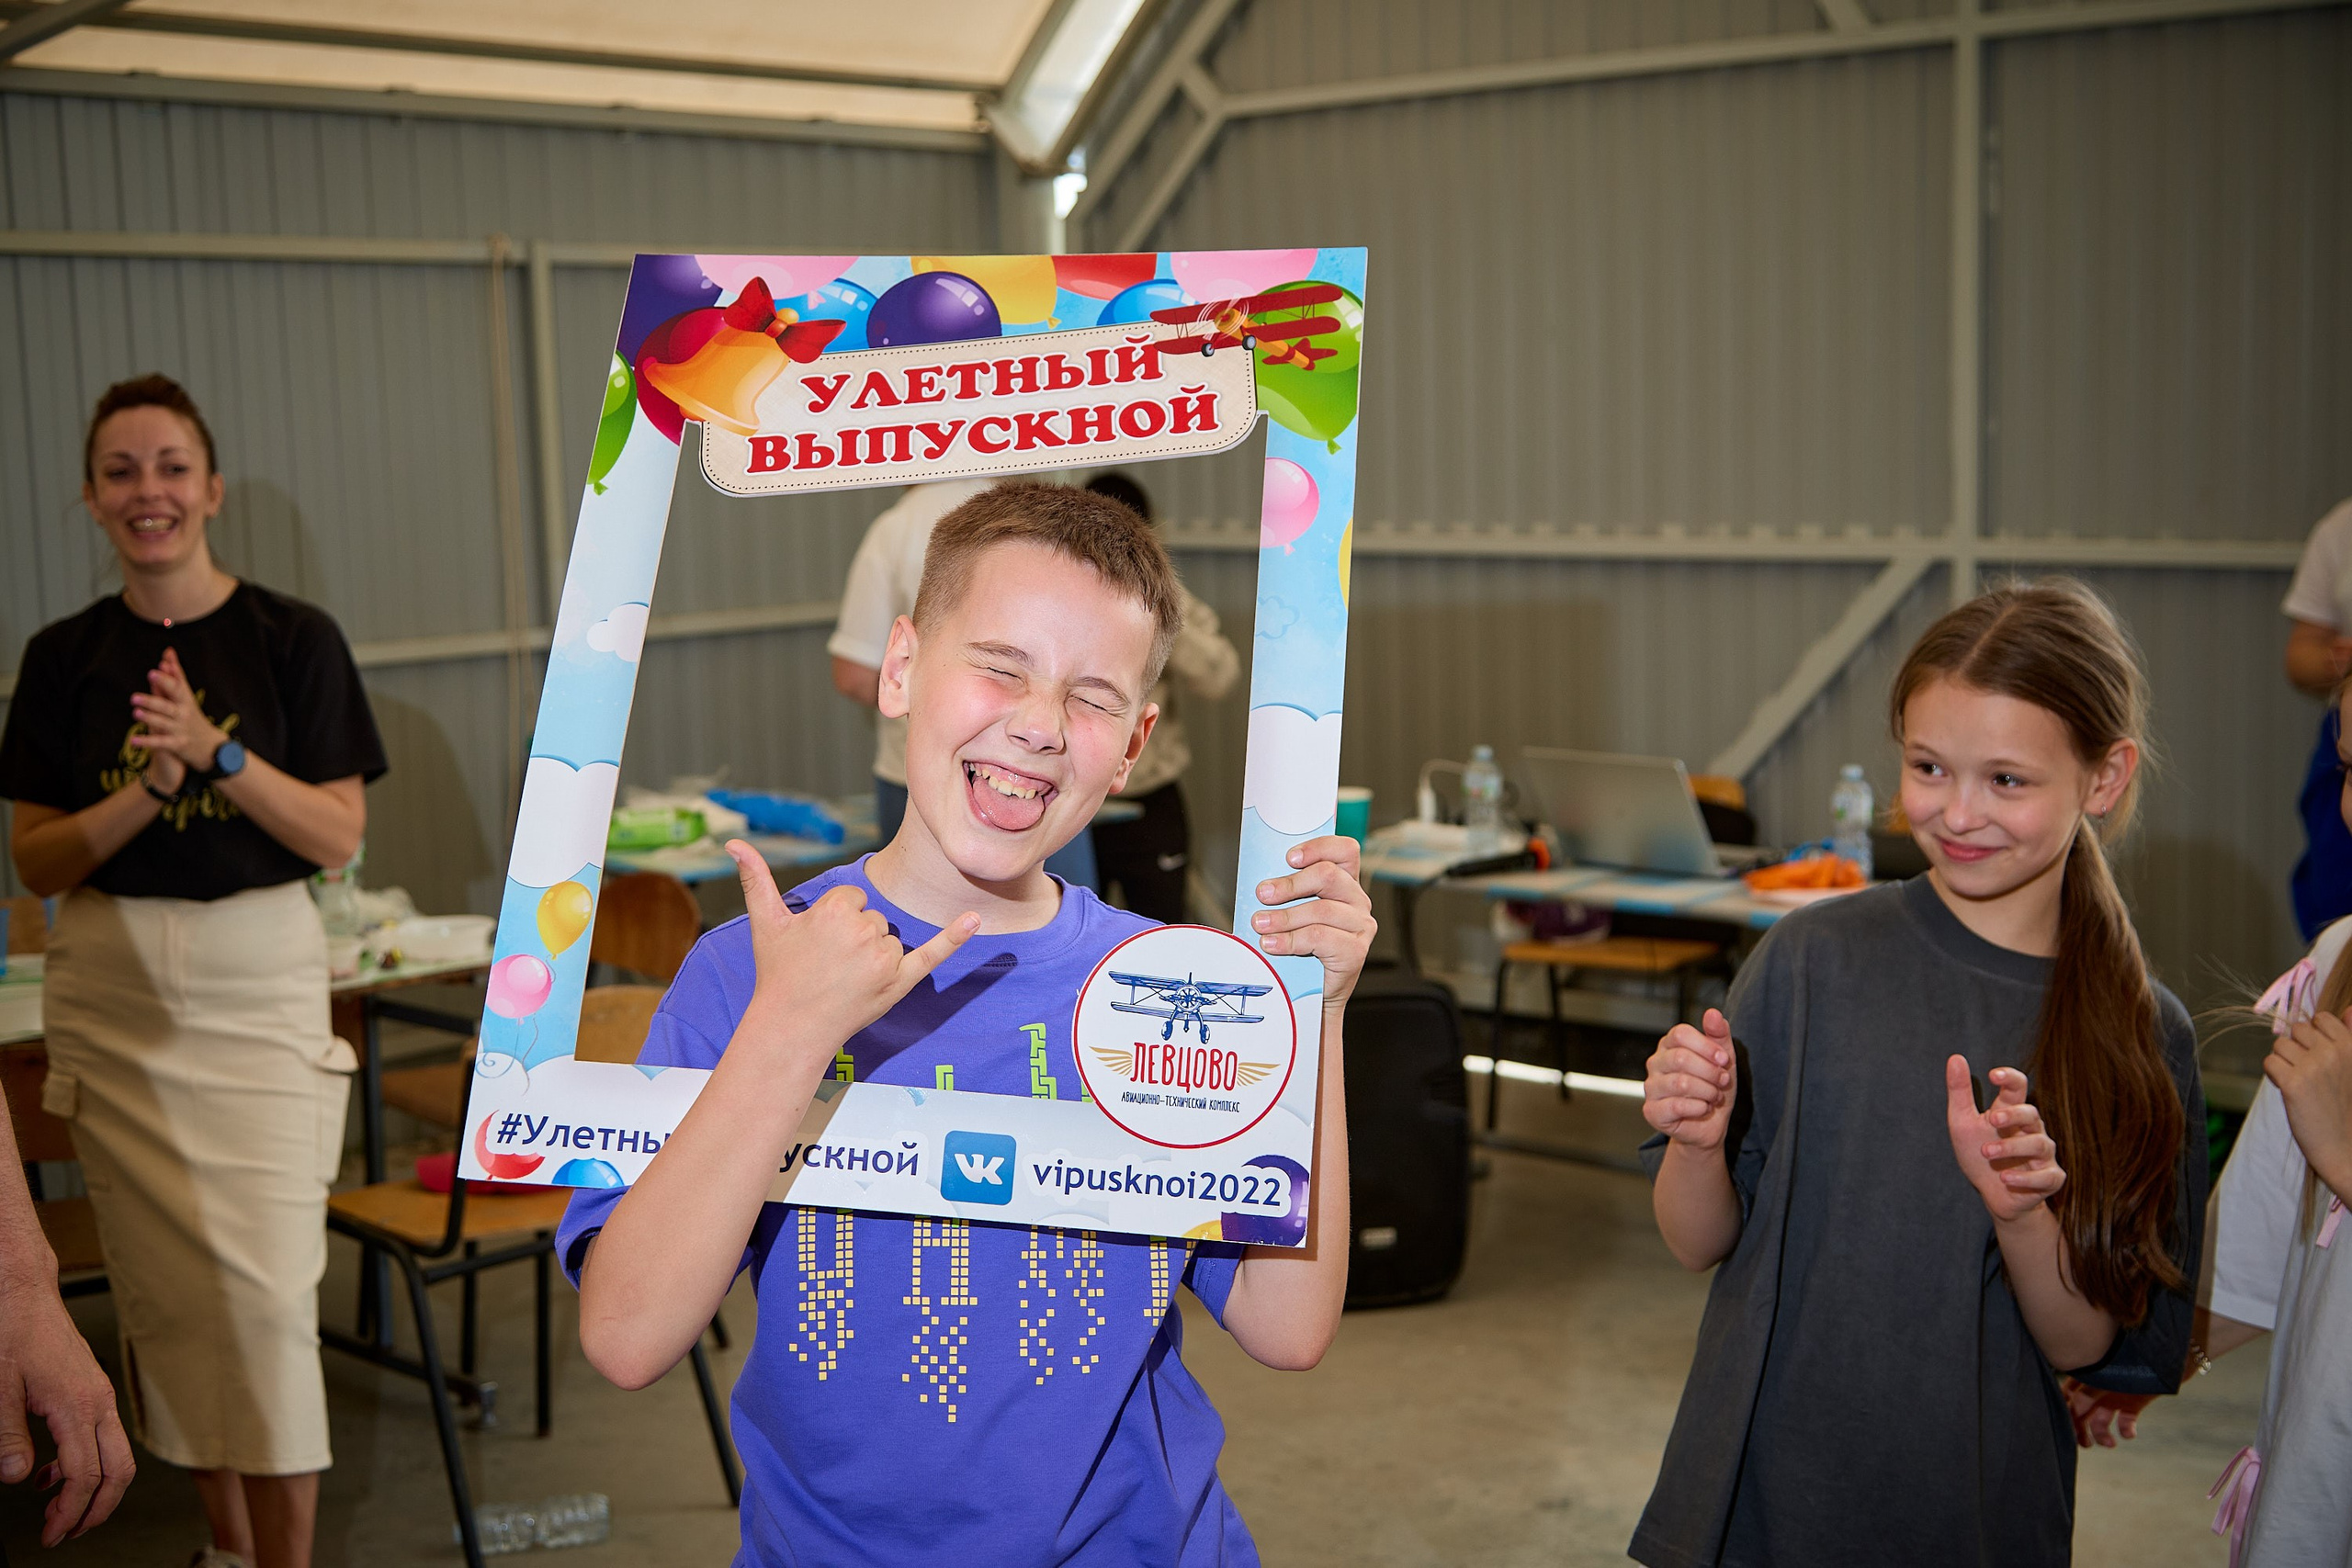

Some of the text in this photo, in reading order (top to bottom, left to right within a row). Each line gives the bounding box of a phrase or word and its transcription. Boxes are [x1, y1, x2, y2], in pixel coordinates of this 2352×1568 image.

[800, 333, 1164, 413] УЛЕТНЫЙ
[743, 384, 1221, 474] ВЫПУСКНОЙ
[1130, 1042, 1238, 1093] ЛЕВЦОВО
[1208, 1099, 1240, 1113] КОМПЛЕКС
[1033, 1158, 1282, 1208] vipusknoi2022
